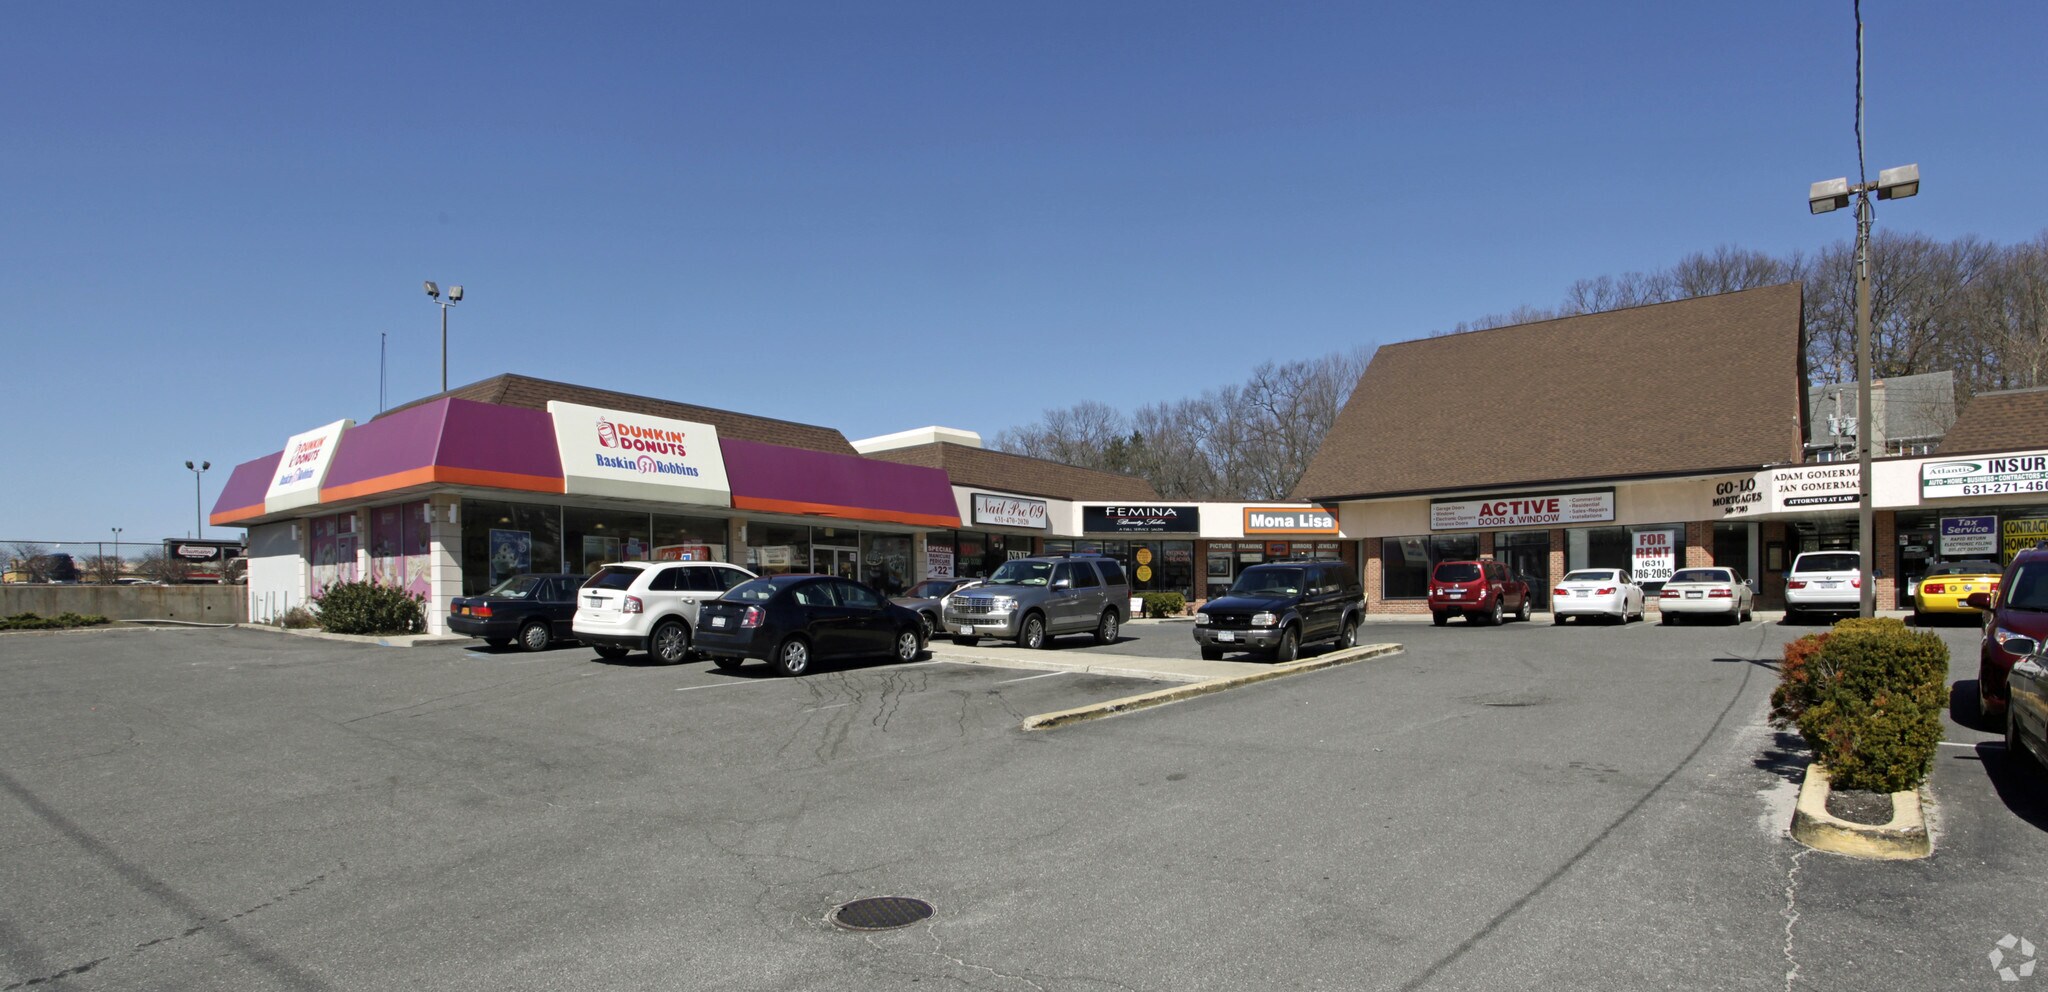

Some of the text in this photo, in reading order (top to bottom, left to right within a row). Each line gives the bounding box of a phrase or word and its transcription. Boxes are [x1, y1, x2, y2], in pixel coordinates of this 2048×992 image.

[617, 423, 686, 444] DUNKIN'
[620, 437, 687, 457] DONUTS
[595, 453, 637, 471] Baskin
[656, 460, 699, 477] Robbins
[1929, 466, 1973, 475] Atlantic
[1773, 472, 1803, 481] ADAM
[1967, 475, 1995, 483] BUSINESS
[1998, 473, 2041, 481] CONTRACTORS
[1716, 477, 1756, 496] GO-LO
[1778, 484, 1797, 493] JAN
[1712, 492, 1762, 507] MORTGAGES
[1788, 497, 1828, 505] ATTORNEYS
[977, 496, 1007, 515] Nail
[1479, 498, 1560, 517] ACTIVE
[1105, 506, 1178, 517] FEMINA
[1116, 518, 1166, 526] Beauty Salon
[1250, 513, 1333, 528] Mona Lisa
[1478, 514, 1561, 526] DOOR & WINDOW
[1957, 519, 1979, 527] Tax
[1946, 526, 1989, 534] Service
[2004, 521, 2048, 534] CONTRACT
[1639, 533, 1667, 546] FOR
[927, 545, 953, 553] SPECIAL
[1635, 546, 1671, 559] RENT
[1641, 560, 1665, 568] (631)
[1634, 568, 1673, 579] 786-2095
